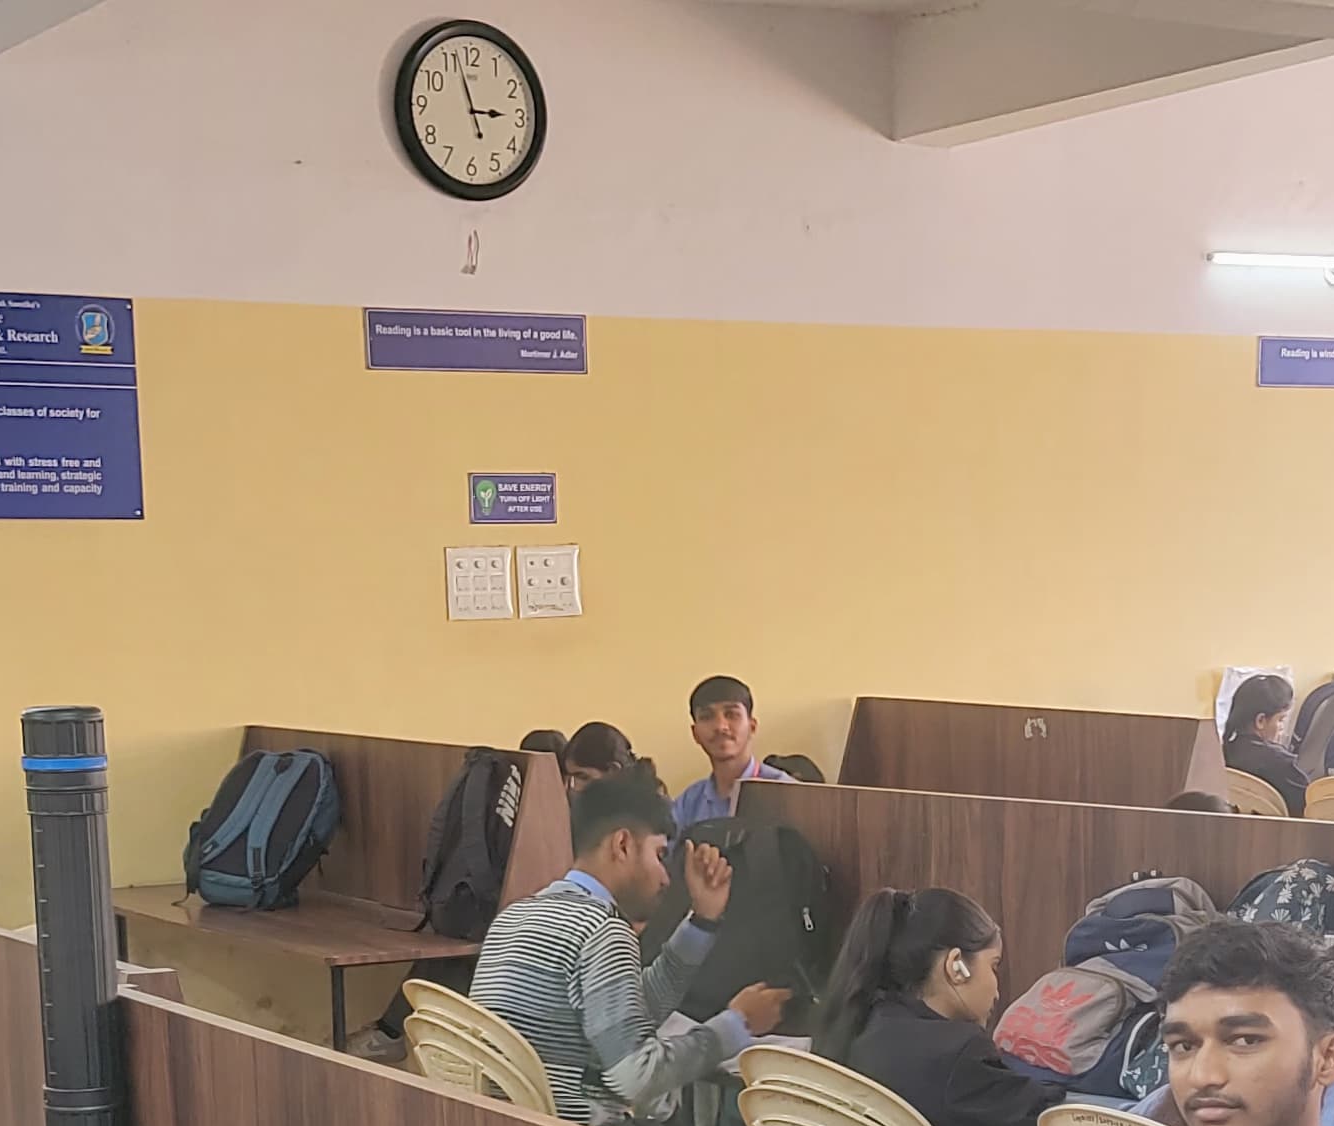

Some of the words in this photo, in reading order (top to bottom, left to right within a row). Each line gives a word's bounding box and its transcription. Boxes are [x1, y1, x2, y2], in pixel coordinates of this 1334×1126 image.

[443, 52, 457, 72] 11
[463, 46, 480, 67] 12
[491, 57, 497, 78] 1
[425, 70, 444, 92] 10
[507, 79, 517, 99] 2
[416, 95, 427, 116] 9
[515, 108, 525, 128] 3
[425, 124, 436, 145] 8
[507, 135, 516, 154] 4
[443, 146, 453, 166] 7
[489, 153, 500, 172] 5
[466, 156, 477, 176] 6
[7, 329, 59, 343] Research
[375, 324, 412, 337] Reading
[413, 325, 421, 335] is
[423, 328, 428, 336] a
[430, 326, 453, 336] basic
[455, 327, 472, 337] tool
[473, 327, 481, 337] in
[483, 327, 497, 337] the
[498, 327, 520, 340] living
[522, 329, 531, 339] of
[533, 331, 538, 339] a
[540, 329, 561, 341] good
[1281, 348, 1309, 360] Reading
[37, 406, 47, 417] of
[49, 408, 84, 420] society
[86, 408, 100, 418] for
[4, 456, 25, 467] with
[29, 458, 58, 467] stress
[61, 457, 80, 467] free
[83, 457, 101, 468] and
[61, 471, 102, 482] strategic
[1, 483, 38, 494] training
[41, 483, 59, 493] and
[63, 484, 102, 495] capacity
[498, 483, 518, 491] SAVE
[519, 483, 552, 491] ENERGY
